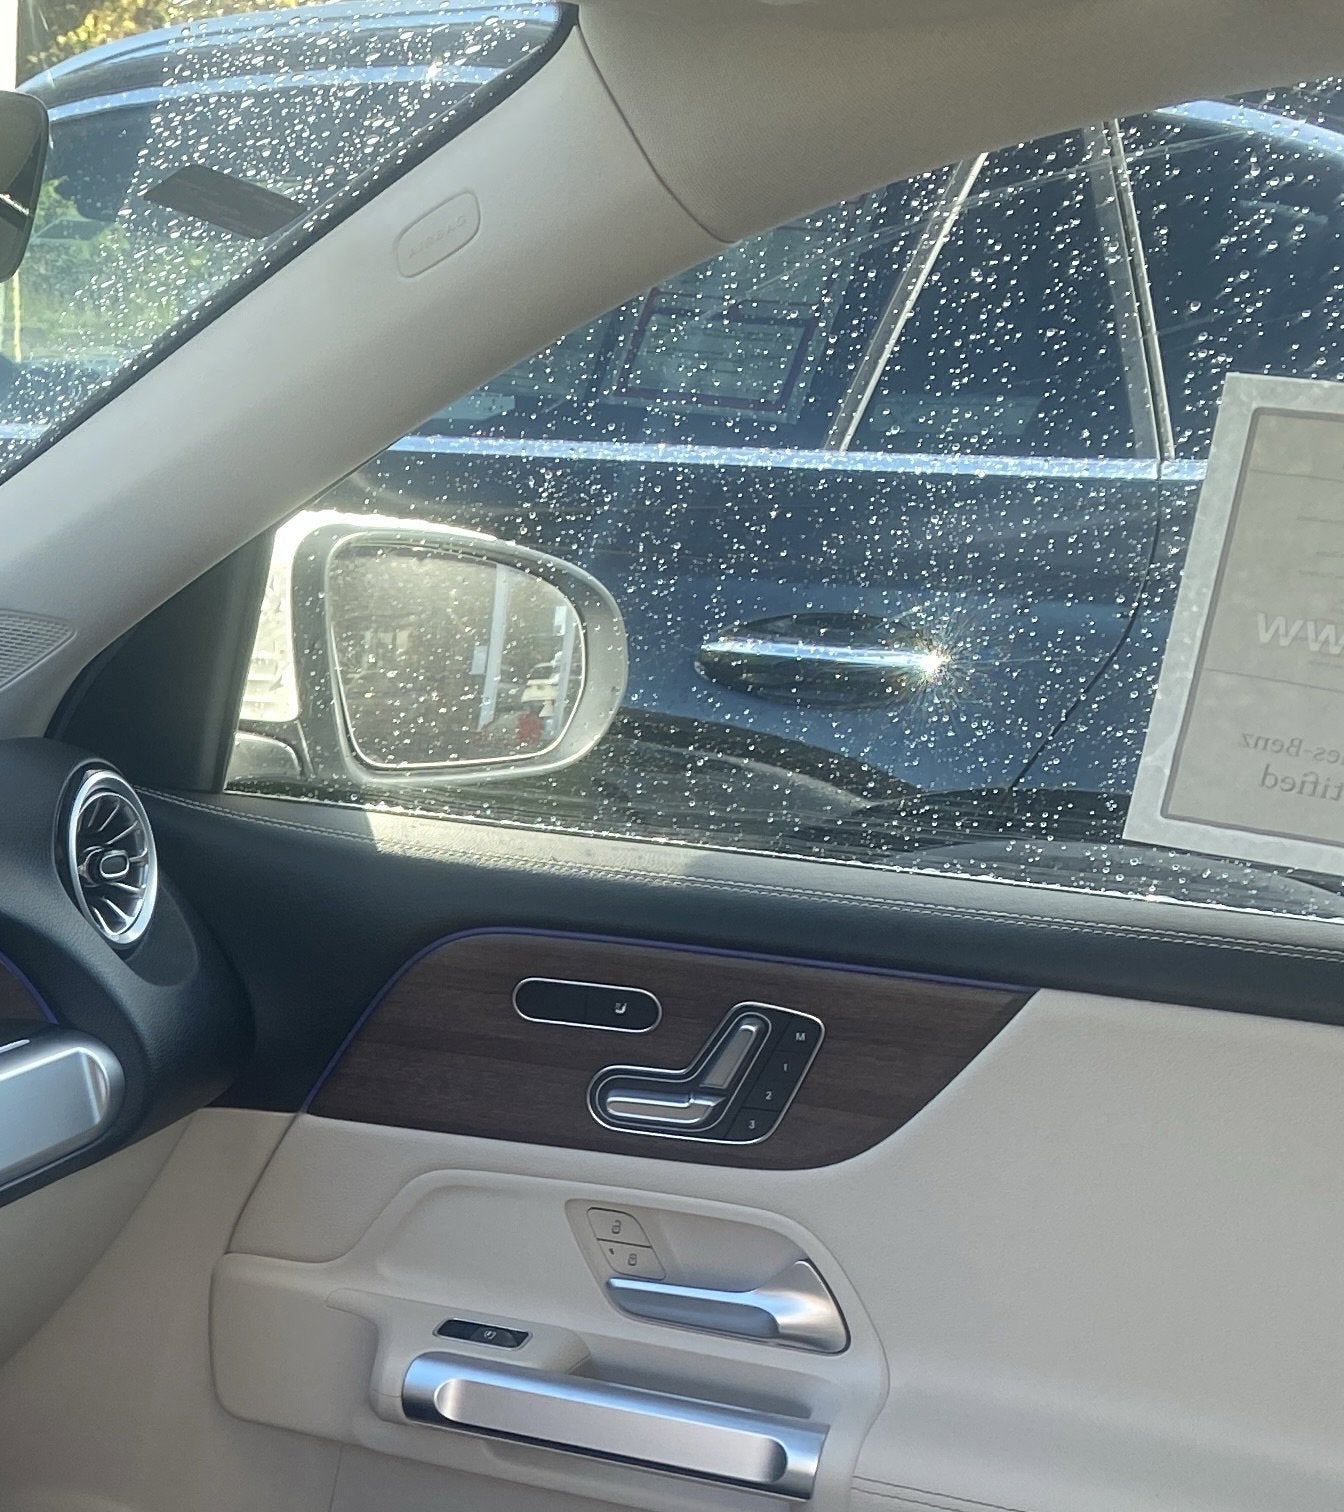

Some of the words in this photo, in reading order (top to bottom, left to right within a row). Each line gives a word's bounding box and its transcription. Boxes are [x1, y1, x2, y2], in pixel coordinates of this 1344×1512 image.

[795, 1032, 806, 1041] M
[765, 1091, 772, 1100] 2
[748, 1120, 755, 1129] 3
